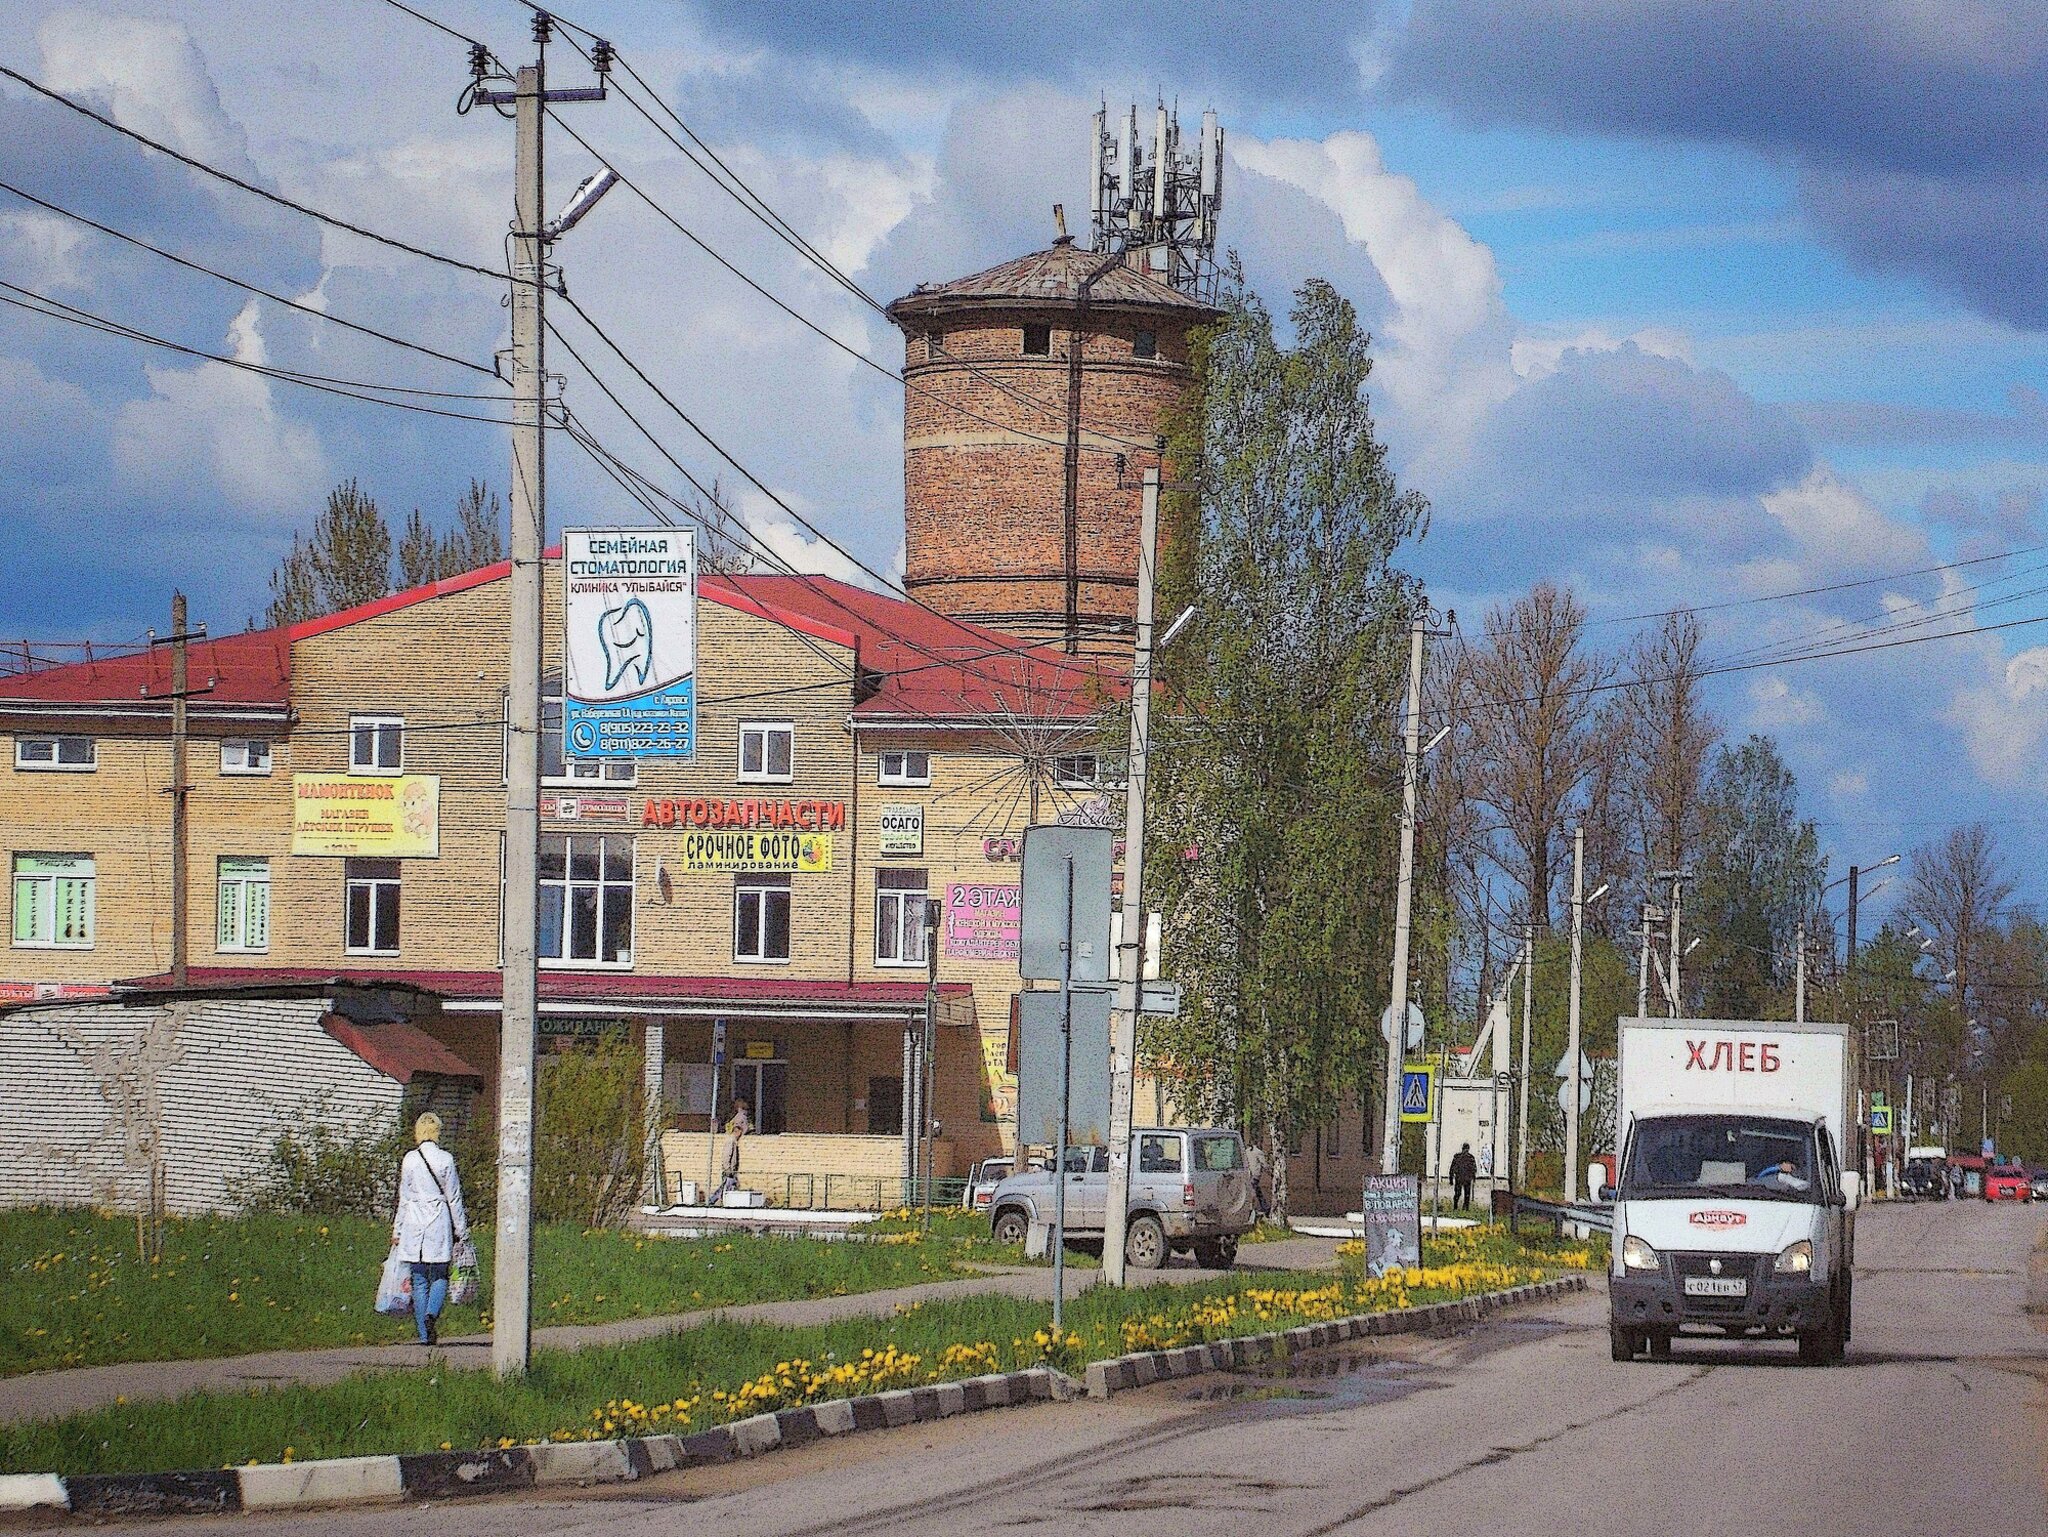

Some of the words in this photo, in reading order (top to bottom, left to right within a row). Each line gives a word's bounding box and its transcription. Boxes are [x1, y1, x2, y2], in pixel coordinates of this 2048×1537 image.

[589, 537, 668, 554] СЕМЕЙНАЯ
[571, 560, 687, 575] СТОМАТОЛОГИЯ
[570, 582, 619, 593] КЛИНИКА
[621, 581, 687, 593] "УЛЫБАЙСЯ"
[321, 809, 369, 819] МАГАЗИН
[641, 798, 846, 831] АВТОЗАПЧАСТИ
[882, 817, 920, 829] ОСАГО
[687, 834, 755, 860] СРОЧНОЕ
[760, 835, 800, 860] ФОТО
[687, 861, 799, 871] ламинирование
[952, 886, 966, 907] 2
[969, 887, 1021, 908] ЭТАЖ
[1686, 1040, 1782, 1072] ХЛЕБ
